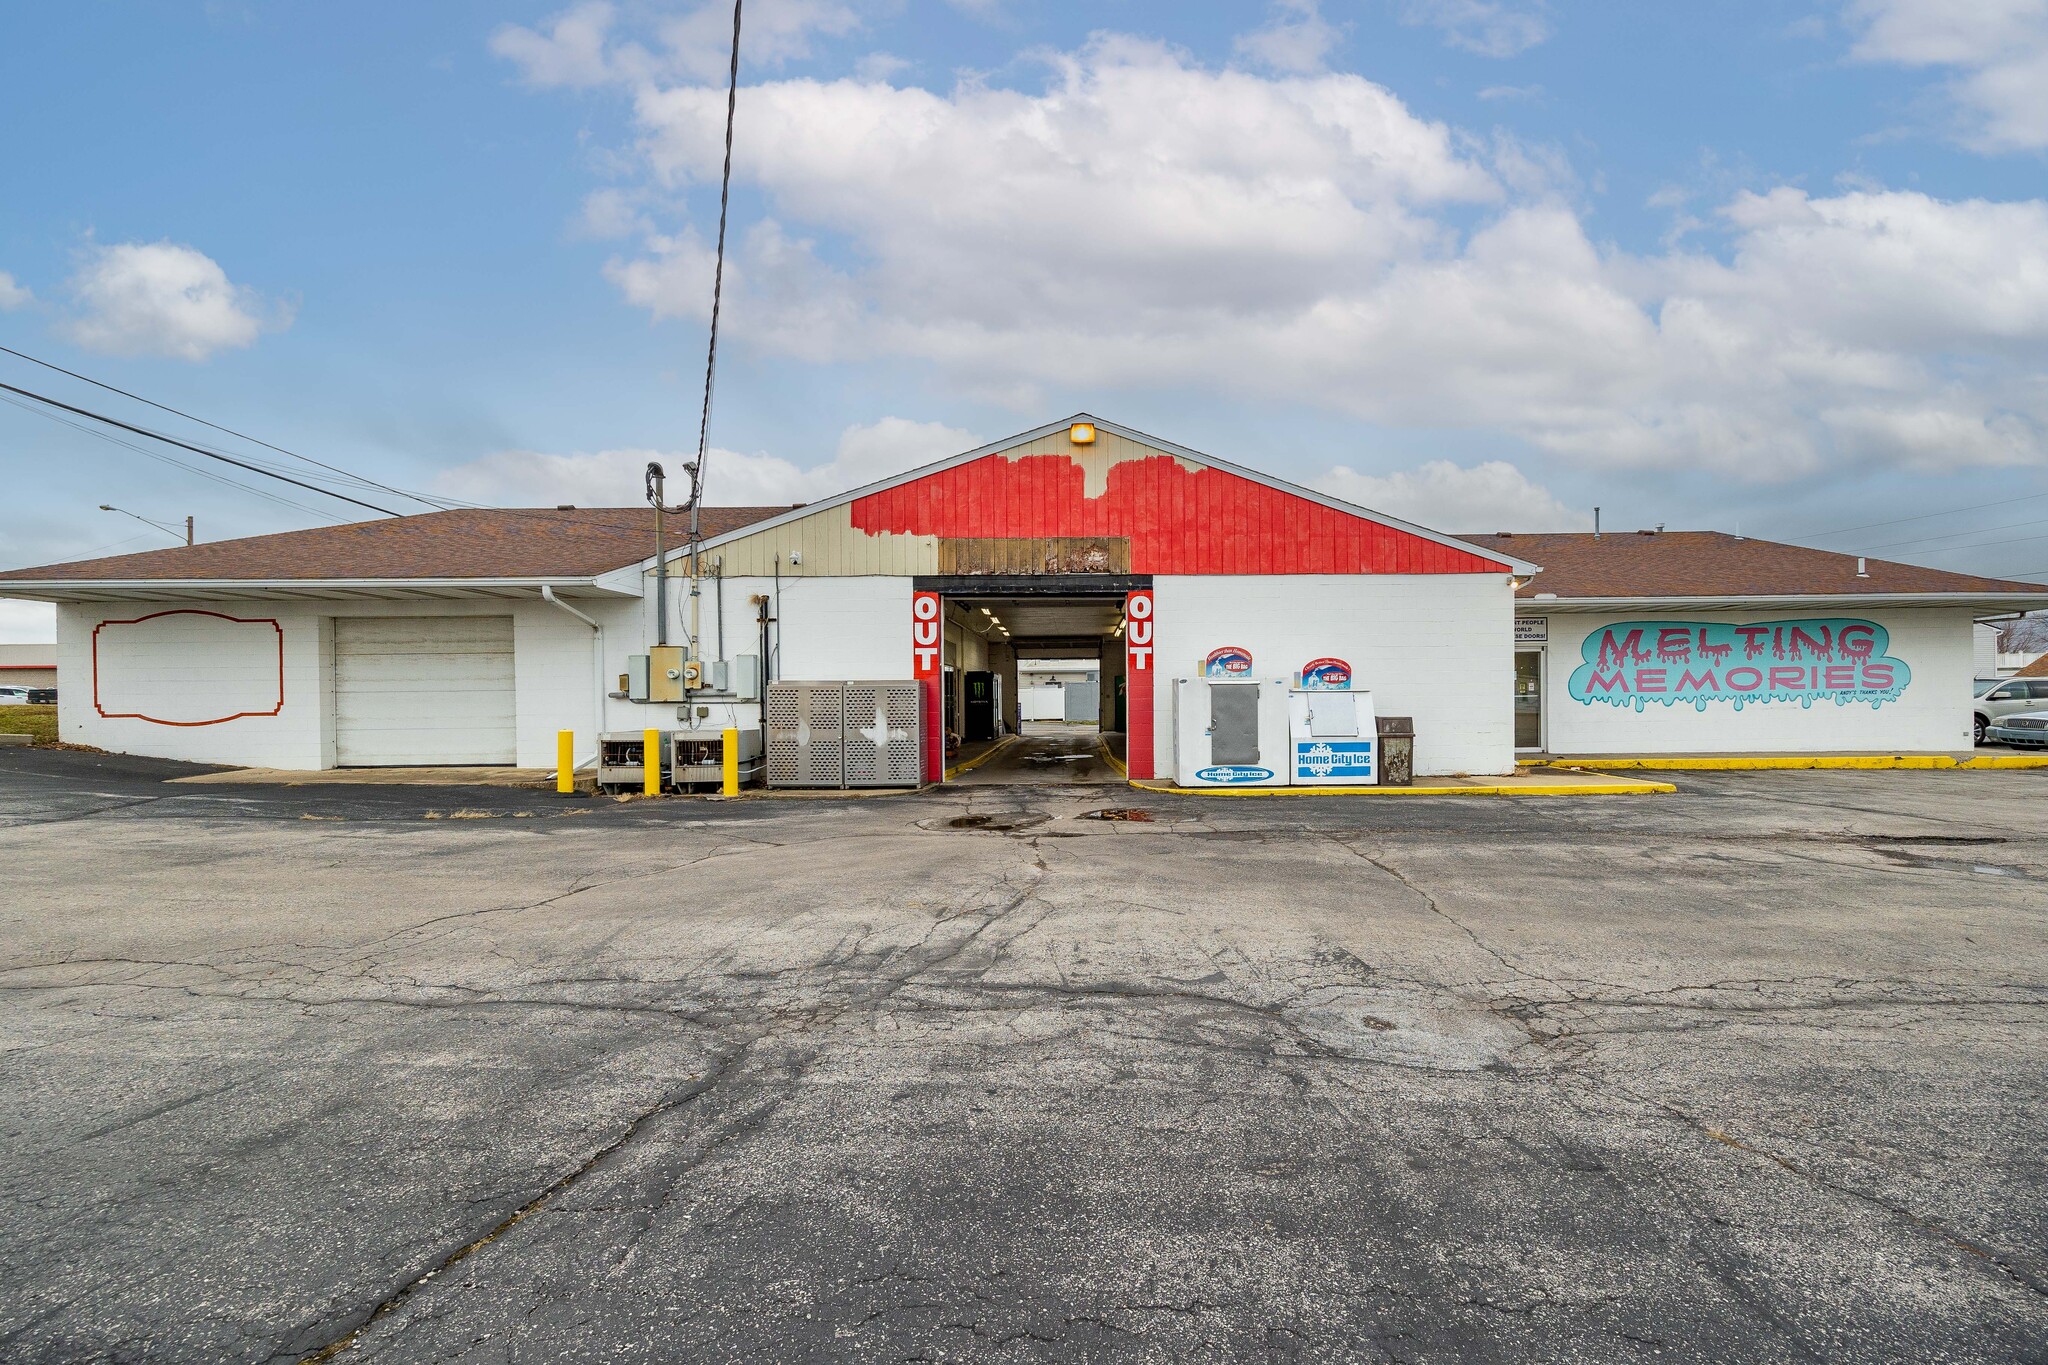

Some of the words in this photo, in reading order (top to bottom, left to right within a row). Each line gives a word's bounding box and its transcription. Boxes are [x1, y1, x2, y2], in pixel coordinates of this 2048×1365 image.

[914, 596, 938, 671] OUT
[1129, 595, 1152, 670] OUT
[1597, 625, 1875, 673] MELTING
[1233, 662, 1241, 670] BIG
[1584, 664, 1895, 693] MEMORIES
[1298, 755, 1330, 765] Home
[1331, 754, 1352, 766] City
[1353, 754, 1371, 764] Ice
